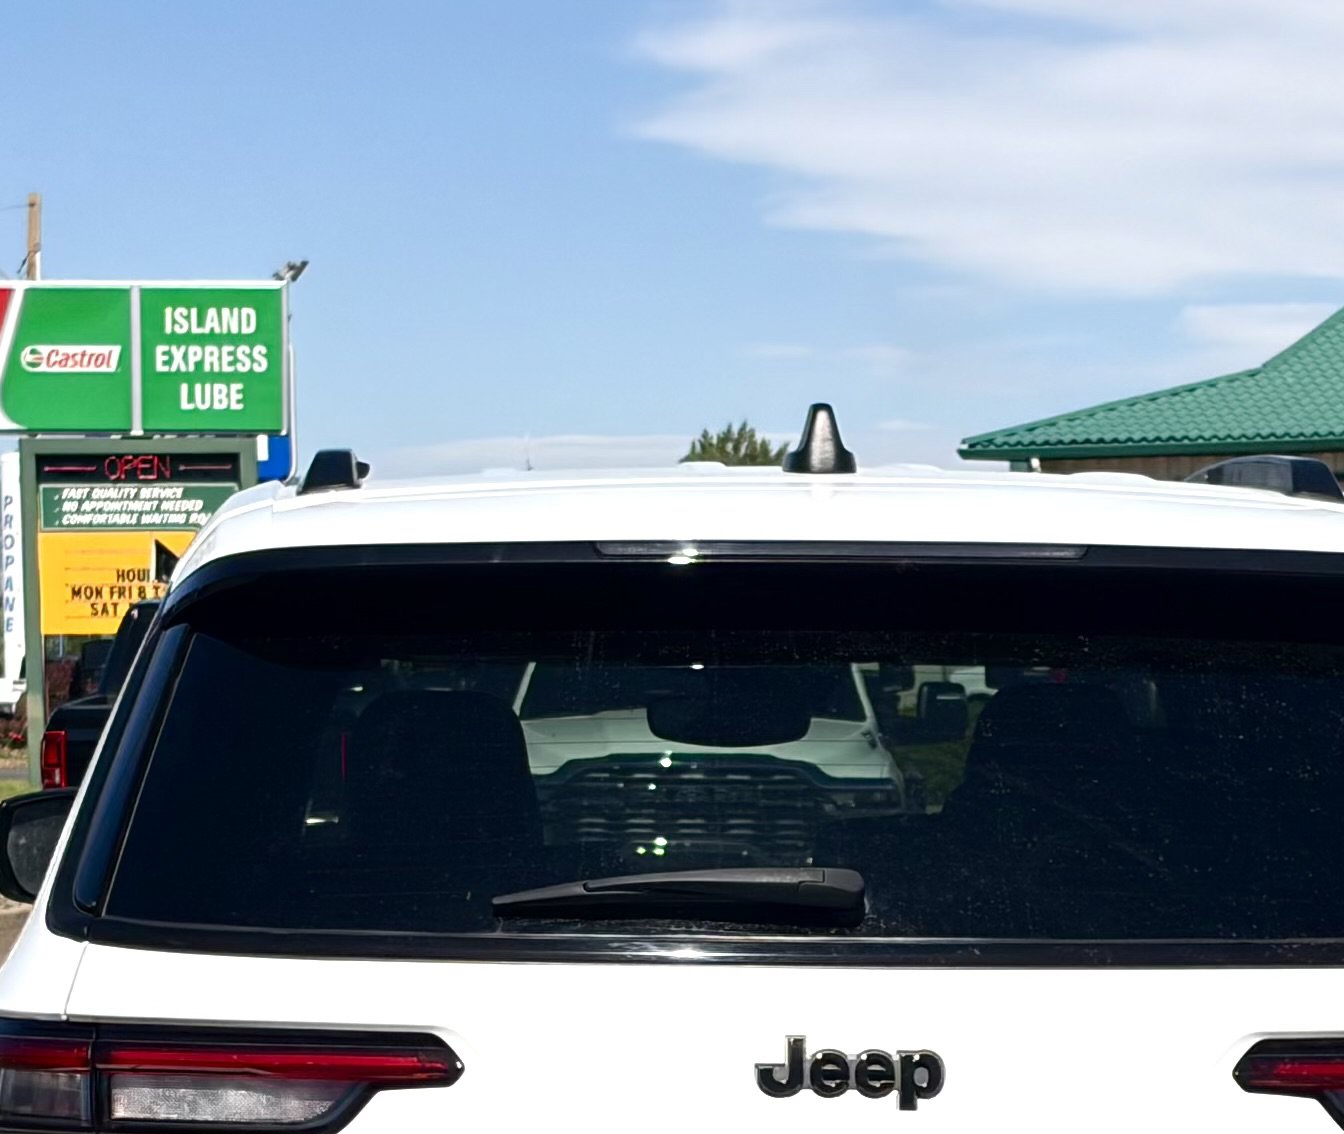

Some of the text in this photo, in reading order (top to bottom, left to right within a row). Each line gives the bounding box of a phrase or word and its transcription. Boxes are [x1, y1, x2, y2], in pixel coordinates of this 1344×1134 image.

[164, 306, 257, 336] ISLAND
[45, 349, 113, 369] Castrol
[154, 344, 268, 374] EXPRESS
[179, 382, 245, 412] LUBE
[104, 455, 172, 480] OPEN
[61, 487, 184, 500] FAST QUALITY SERVICE
[61, 500, 204, 512] NO APPOINTMENT NEEDED
[61, 513, 138, 526] COMFORTABLE
[140, 513, 187, 525] WAITING
[3, 495, 16, 633] PROPANE
[71, 585, 103, 600] MON
[110, 585, 133, 600] FRI
[90, 602, 119, 617] SAT
[754, 1034, 947, 1111] Jeep
